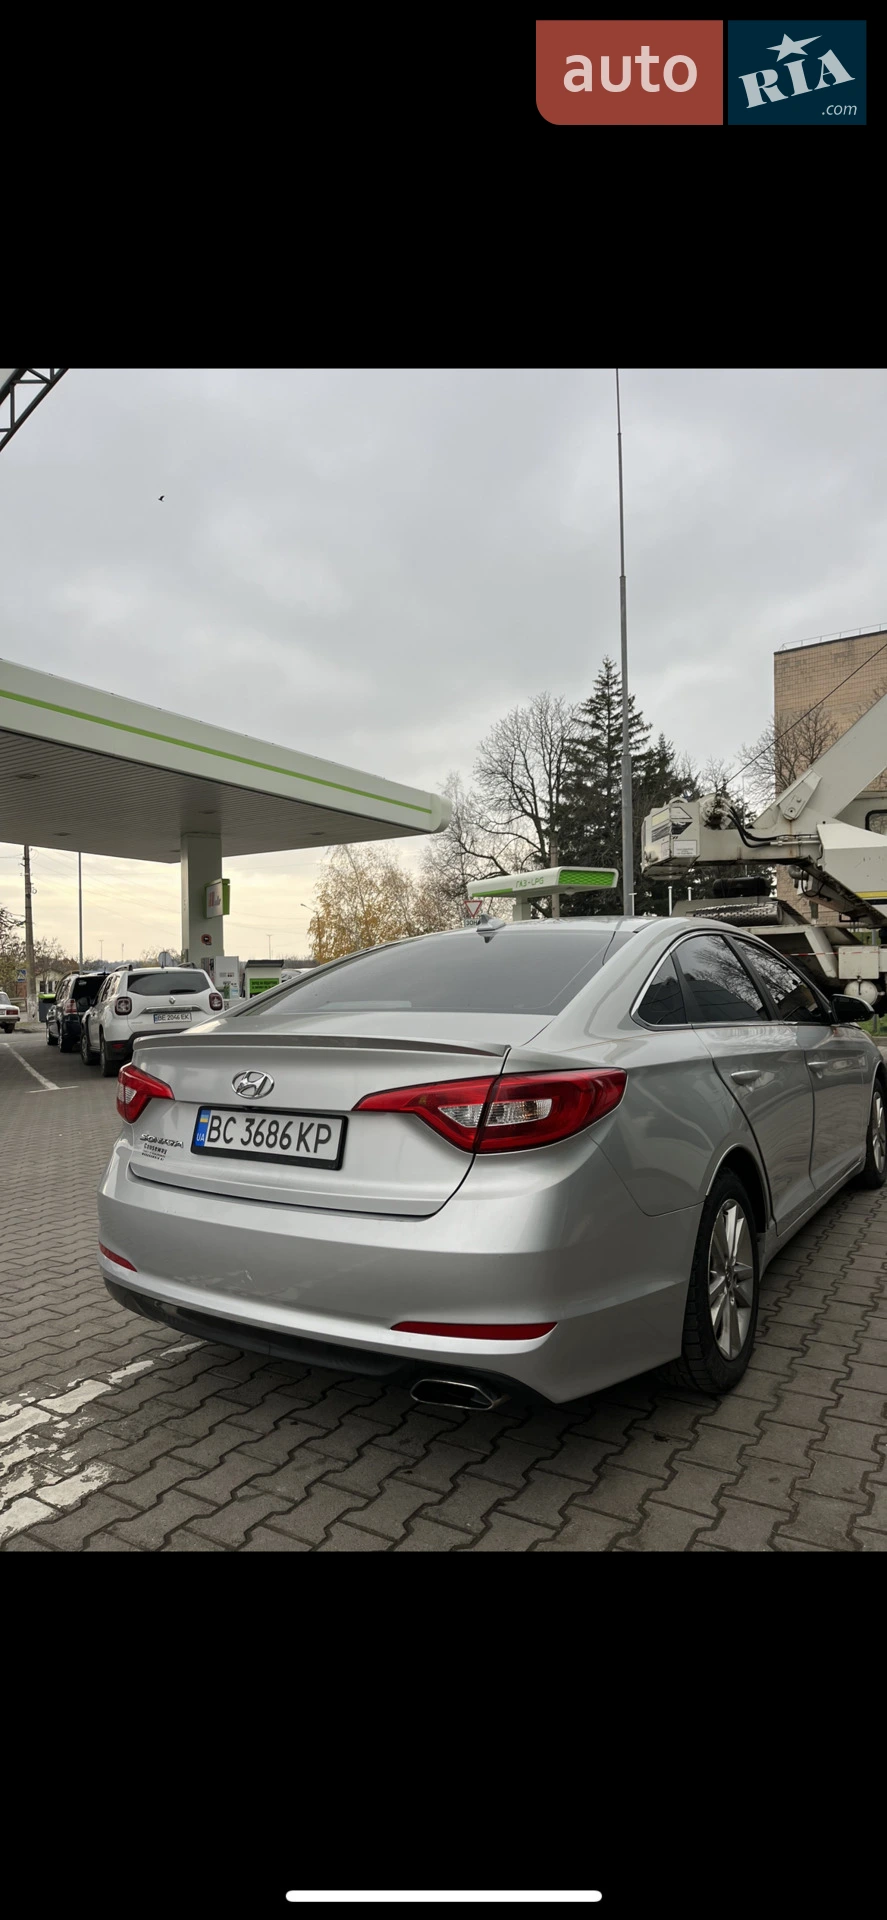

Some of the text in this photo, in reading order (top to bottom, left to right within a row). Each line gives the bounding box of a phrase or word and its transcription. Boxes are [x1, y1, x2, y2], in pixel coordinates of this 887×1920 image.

[196, 1133, 206, 1142] UA
[207, 1115, 333, 1154] BC 3686 KP
